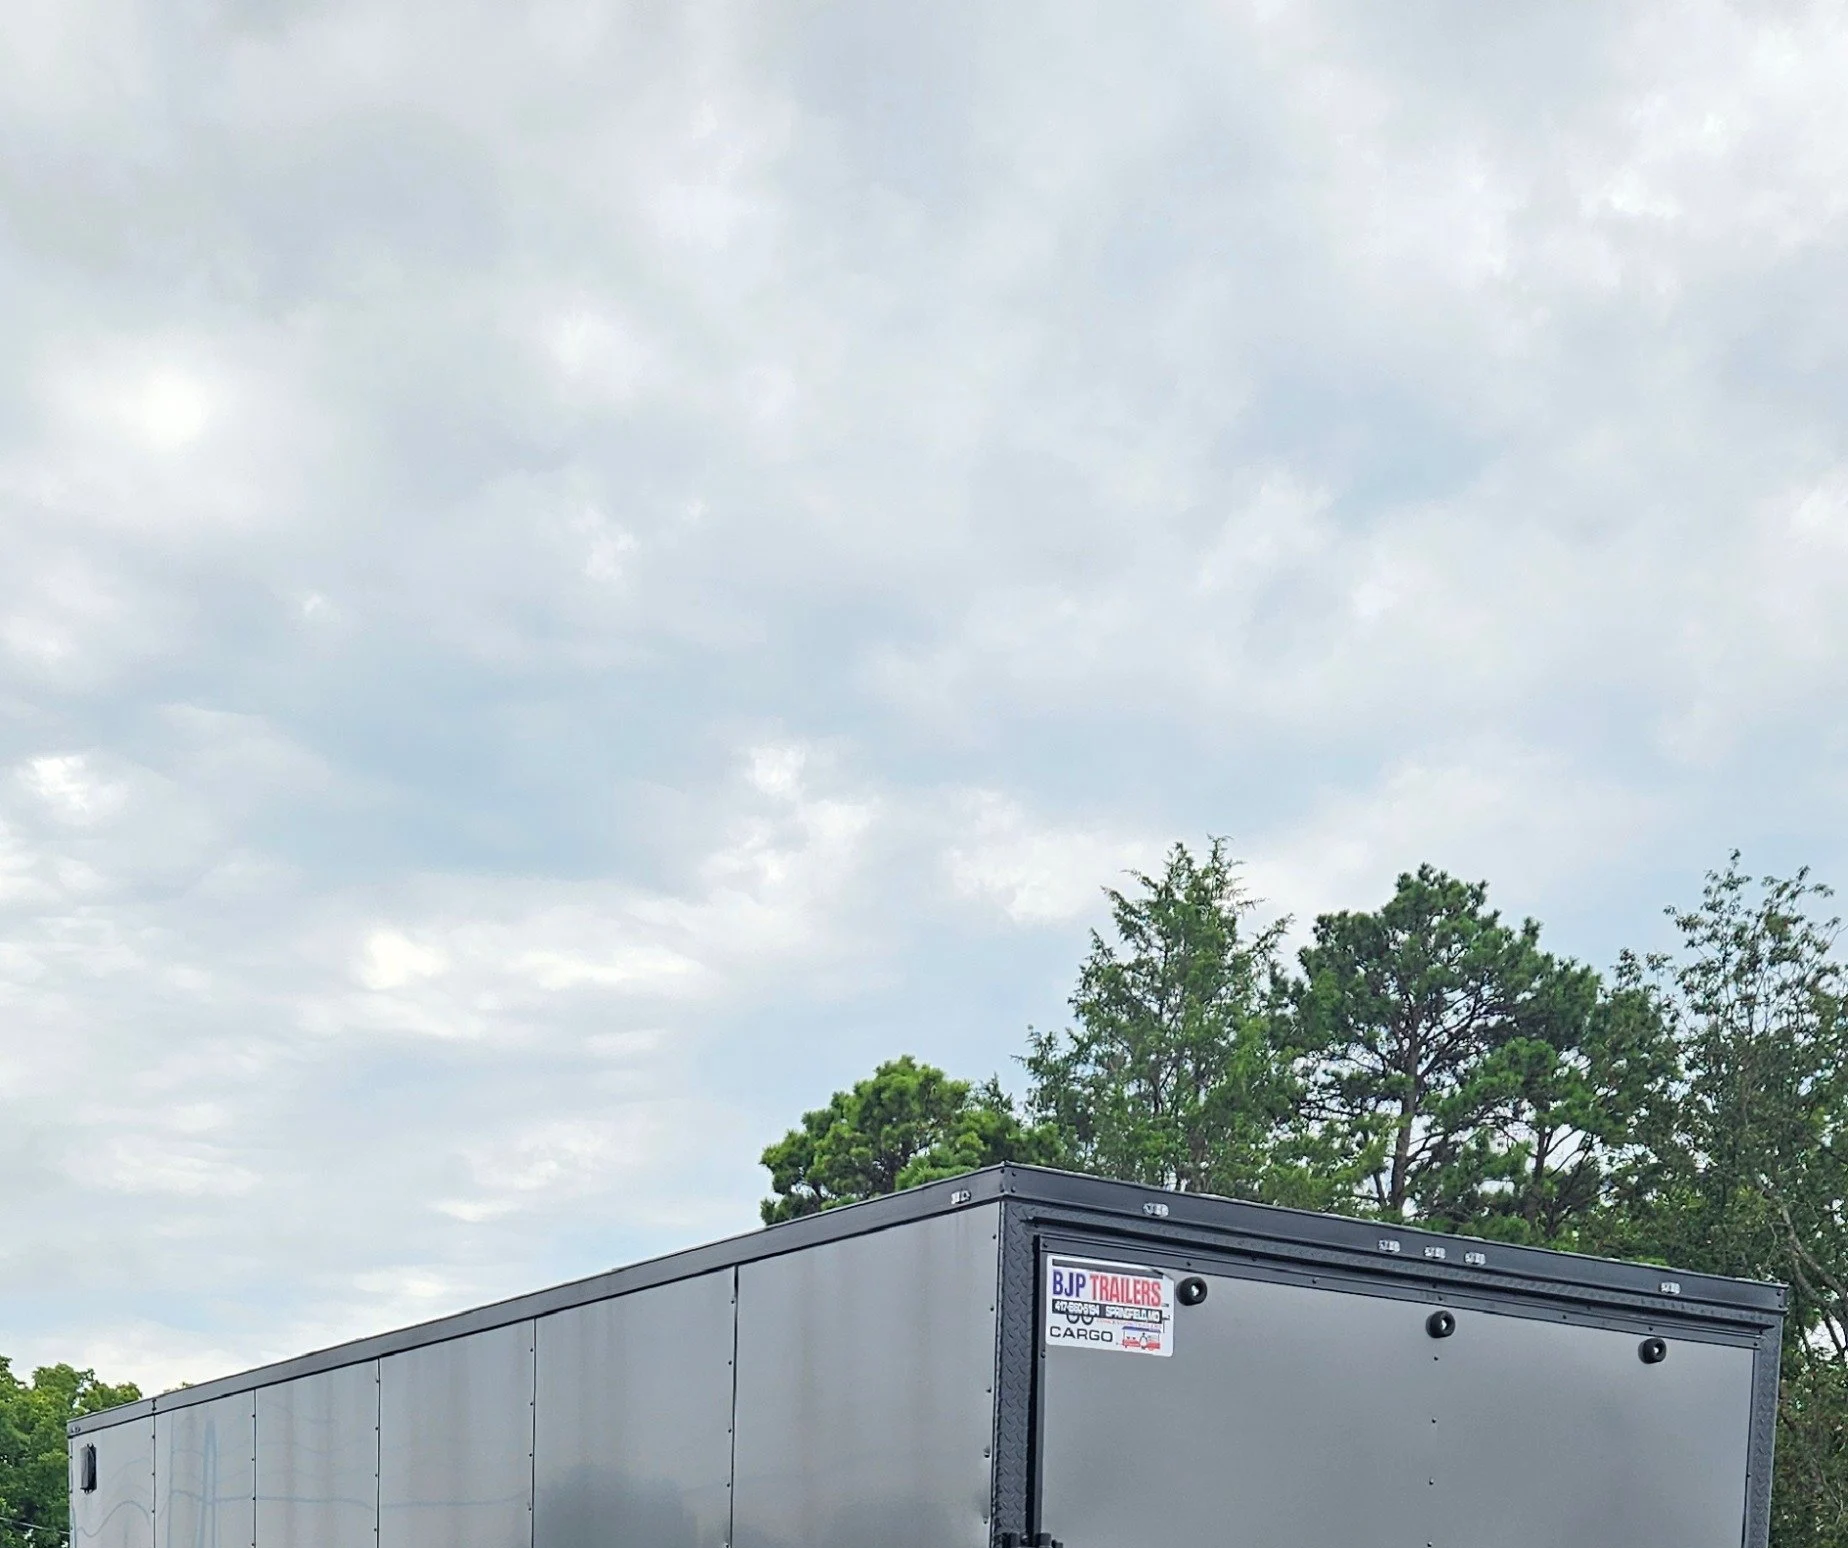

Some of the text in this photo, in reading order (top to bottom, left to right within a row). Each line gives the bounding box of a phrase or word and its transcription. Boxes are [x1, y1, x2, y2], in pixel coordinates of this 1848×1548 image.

[1053, 1269, 1162, 1307] BJP TRAILERS
[1050, 1326, 1113, 1342] CARGO
